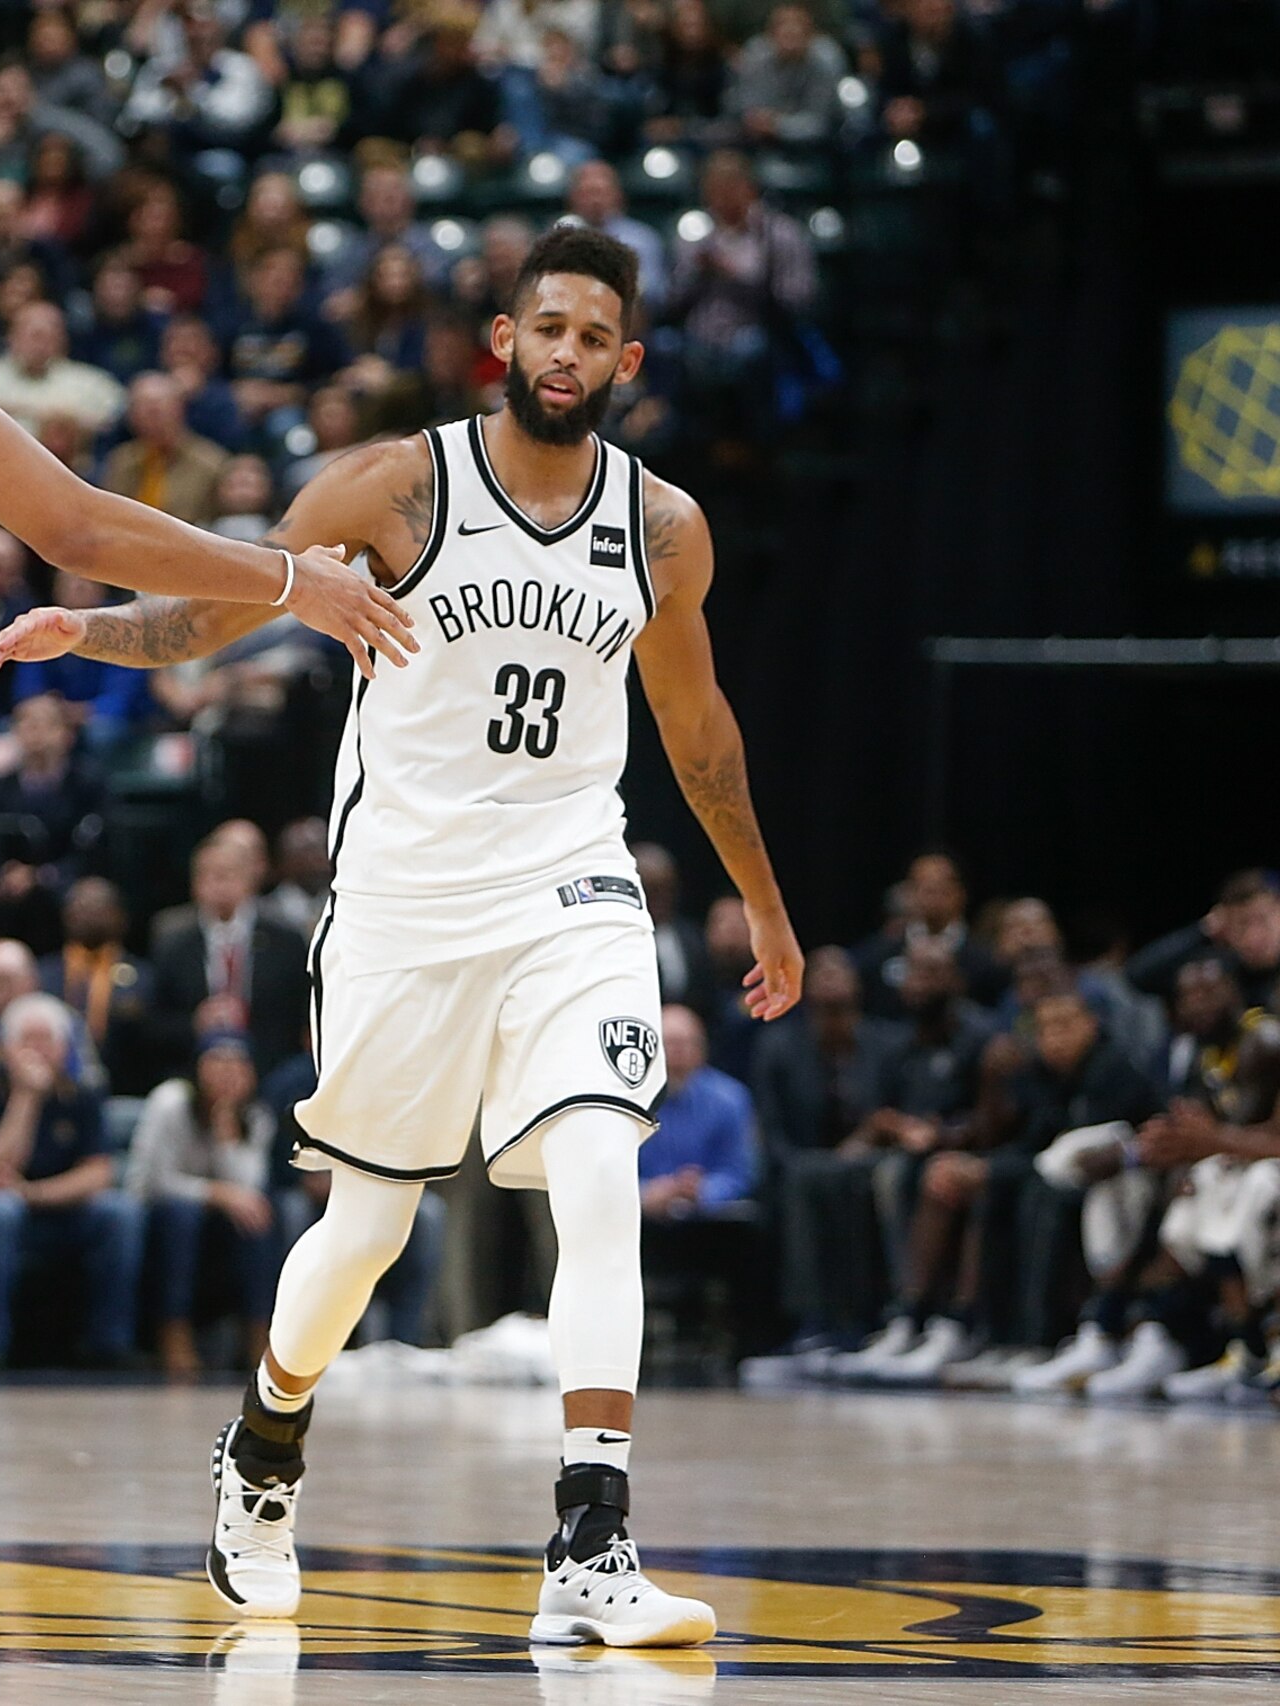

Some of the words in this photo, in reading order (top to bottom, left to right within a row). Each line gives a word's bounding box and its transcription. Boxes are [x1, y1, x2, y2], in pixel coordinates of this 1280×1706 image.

[593, 536, 624, 554] infor
[429, 579, 635, 664] BROOKLYN
[487, 663, 566, 759] 33
[605, 1021, 657, 1058] NETS
